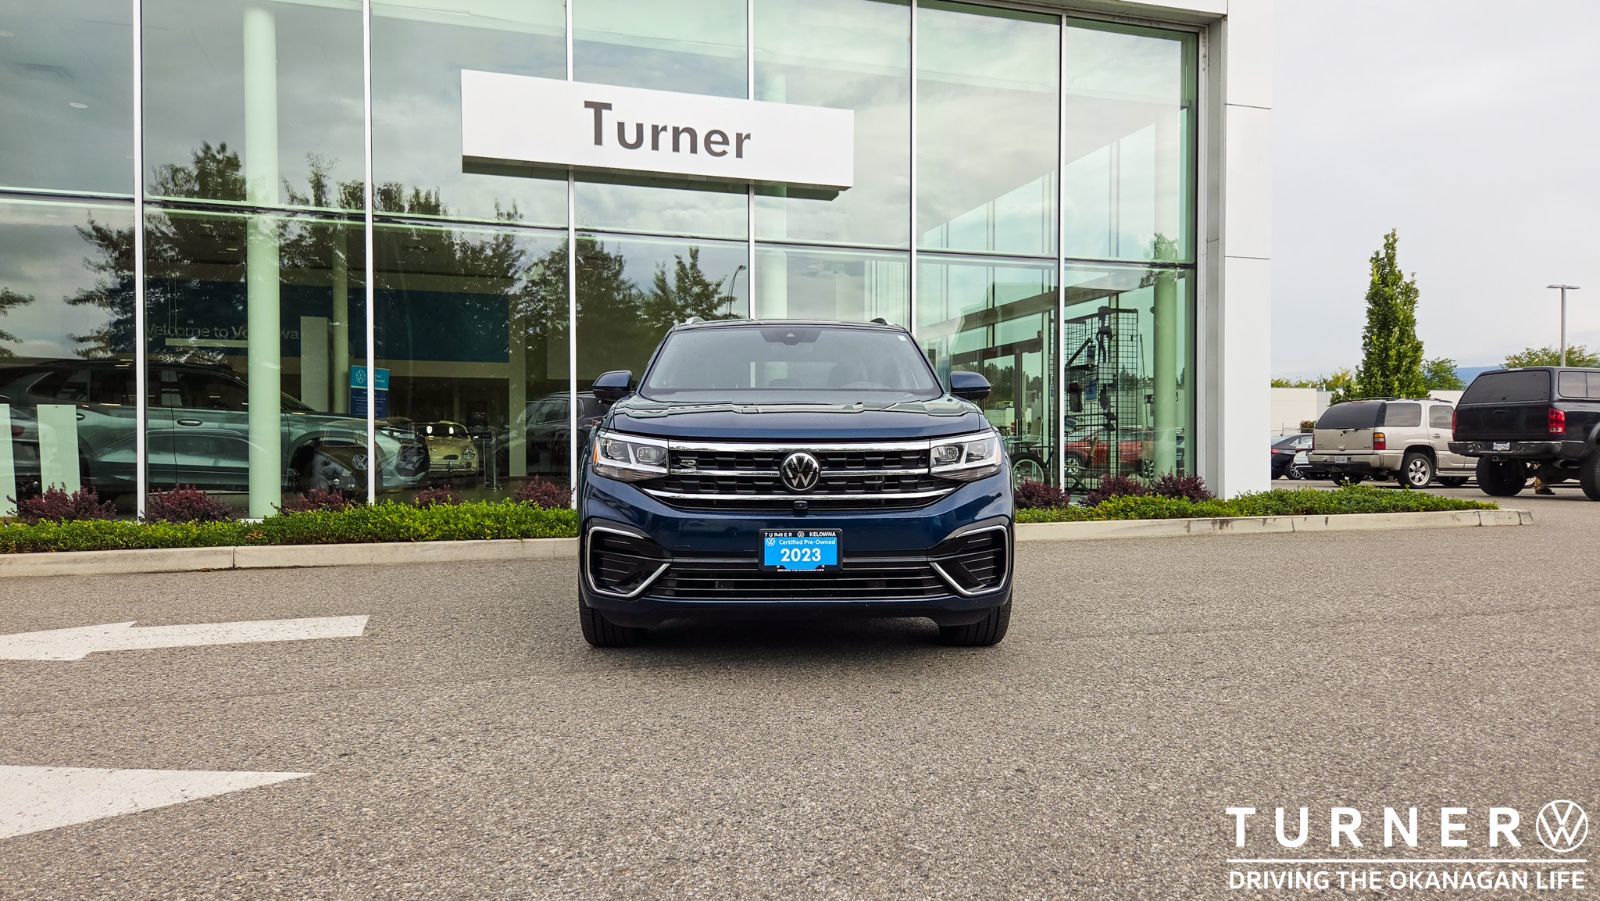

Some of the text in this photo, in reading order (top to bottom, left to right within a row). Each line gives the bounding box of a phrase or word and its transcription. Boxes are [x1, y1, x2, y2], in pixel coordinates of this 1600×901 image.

[583, 100, 752, 159] Turner
[214, 327, 229, 338] to
[780, 547, 822, 562] 2023
